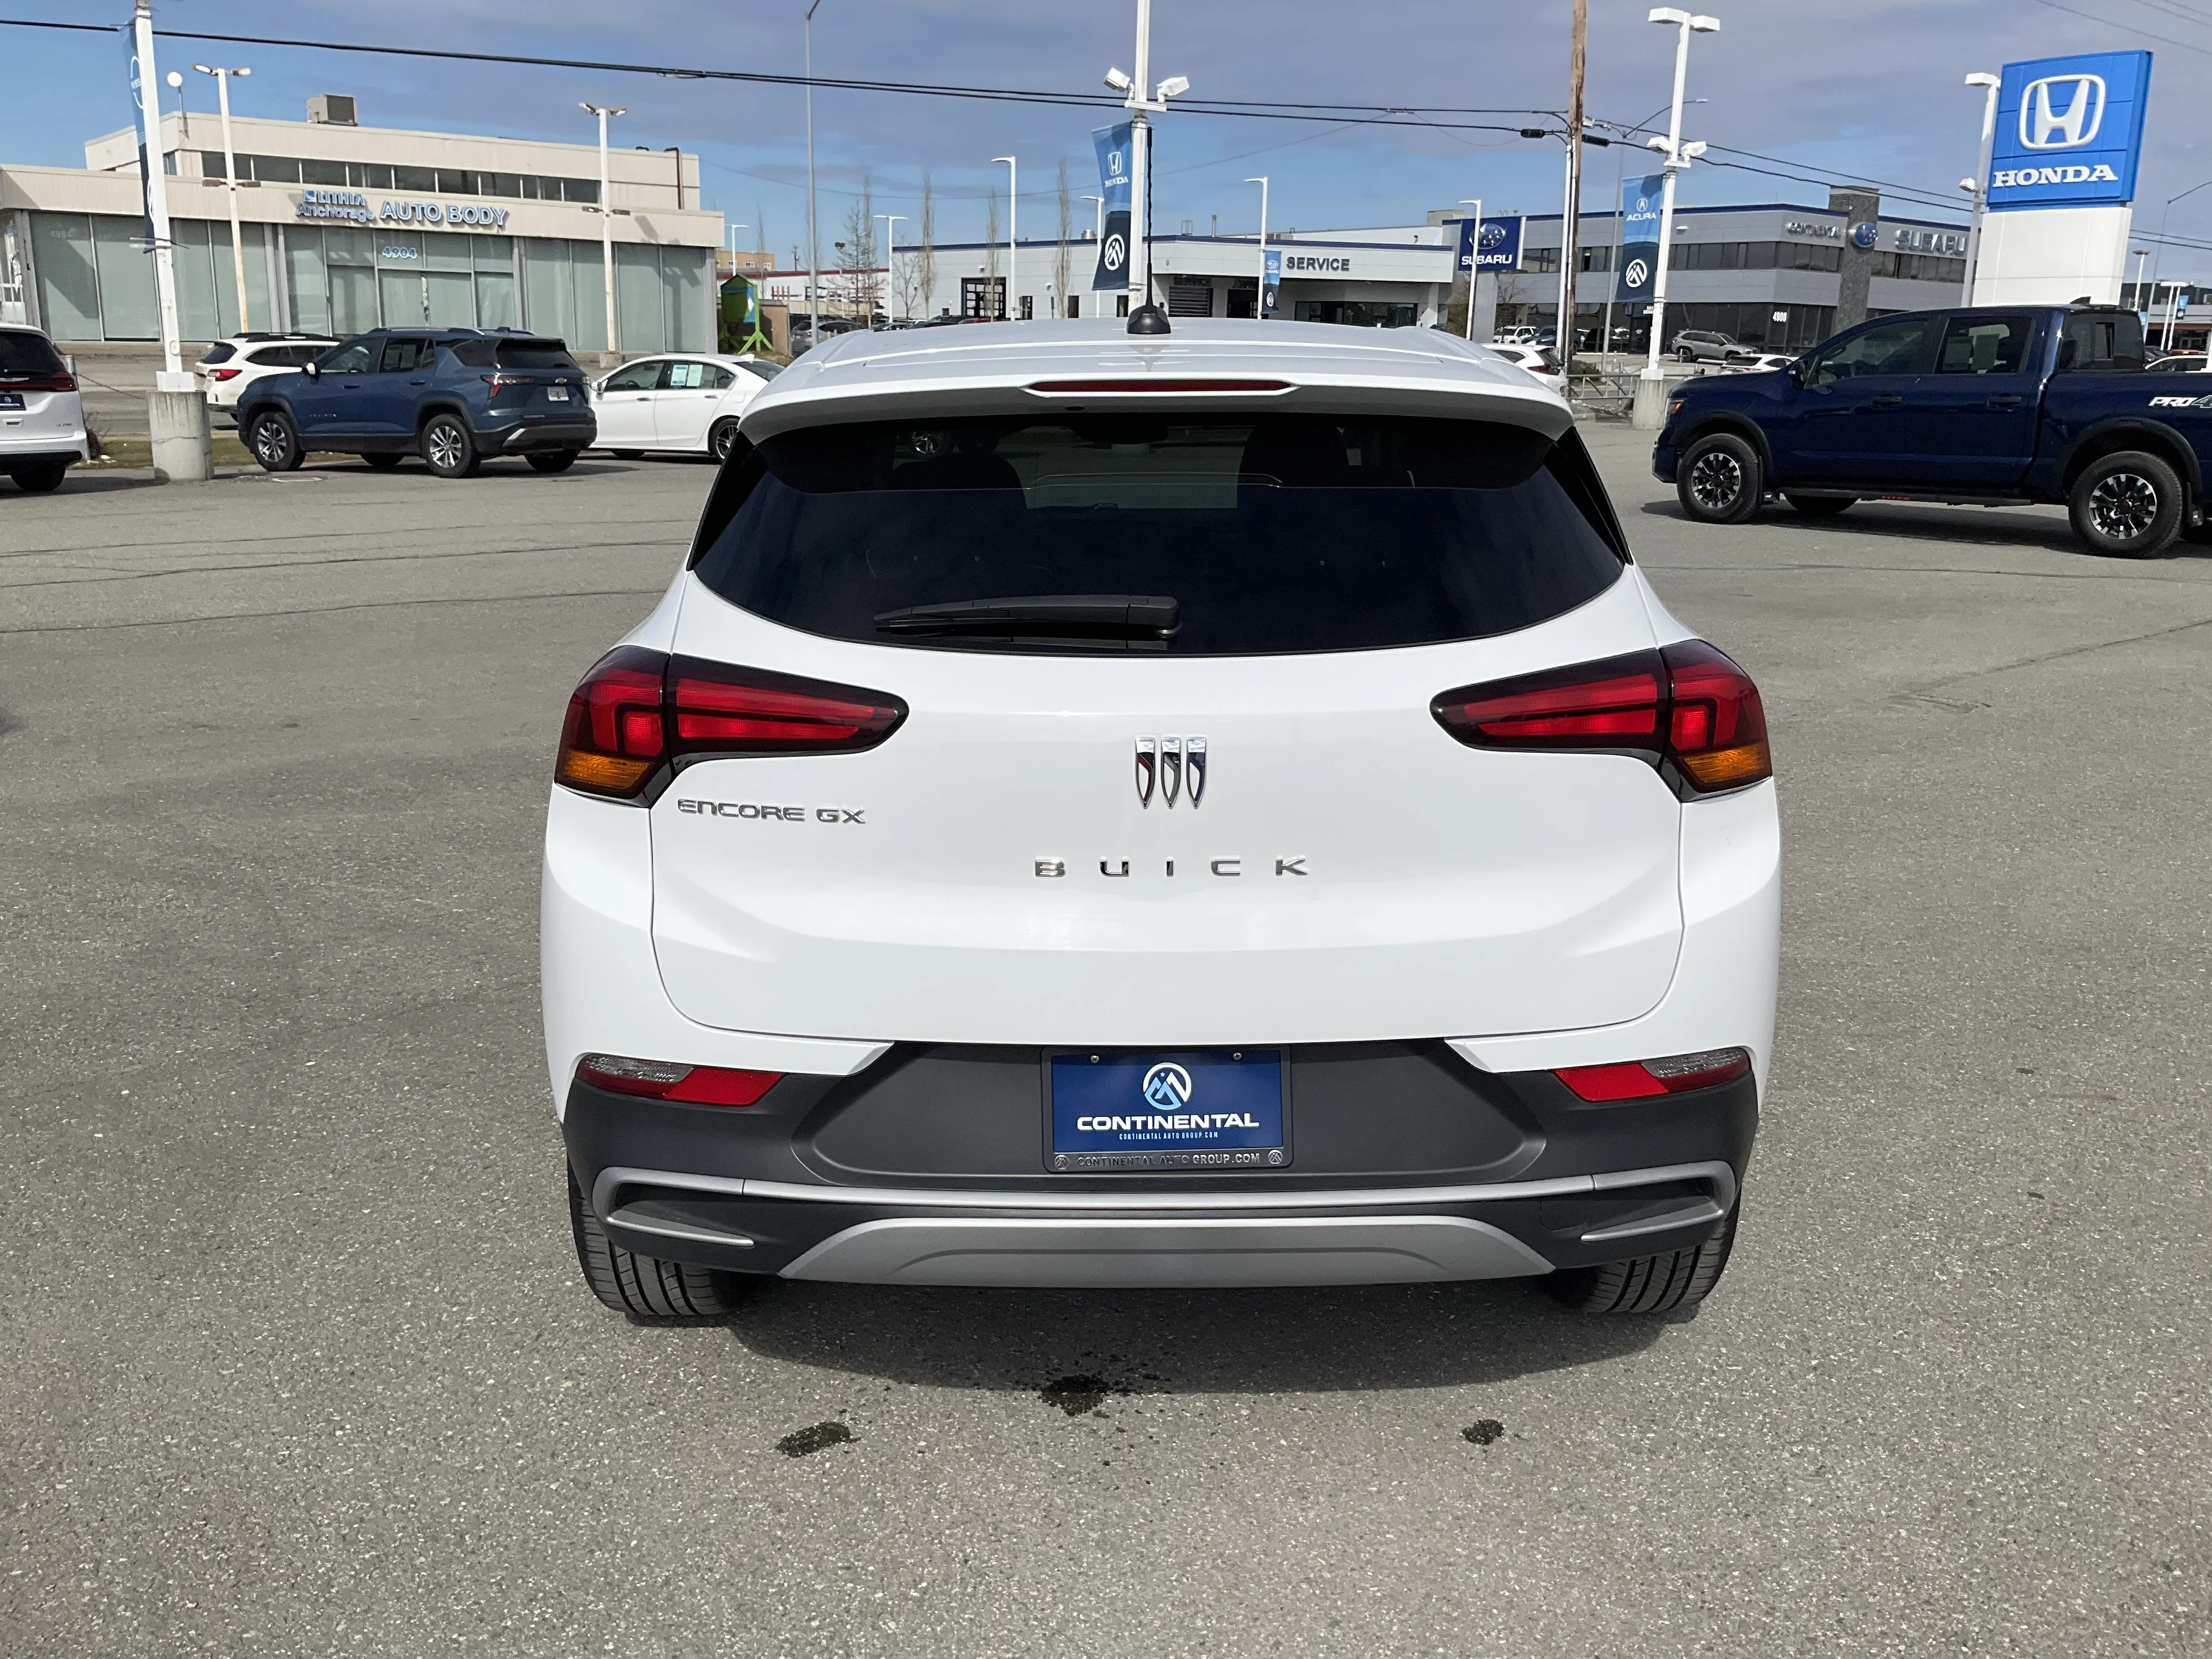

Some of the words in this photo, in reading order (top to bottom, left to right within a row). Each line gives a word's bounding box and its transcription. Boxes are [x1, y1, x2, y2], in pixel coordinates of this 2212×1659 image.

[1104, 176, 1128, 188] HONDA
[1993, 165, 2119, 187] HONDA
[317, 190, 366, 206] LITHIA
[296, 204, 375, 222] Anchorage
[380, 201, 441, 222] AUTO
[447, 205, 508, 225] BODY
[1626, 212, 1656, 222] ACURA
[1895, 229, 1968, 255] SUBARU
[382, 246, 417, 259] 4904
[1286, 257, 1350, 272] SERVICE
[1773, 311, 1787, 322] 4900
[678, 798, 805, 822] ENCORE
[816, 807, 866, 824] GX
[1035, 858, 1308, 877] BUICK
[1077, 1113, 1260, 1131] CONTINENTAL
[1077, 1155, 1156, 1167] CONTINENTAL
[1159, 1154, 1189, 1165] AUTO
